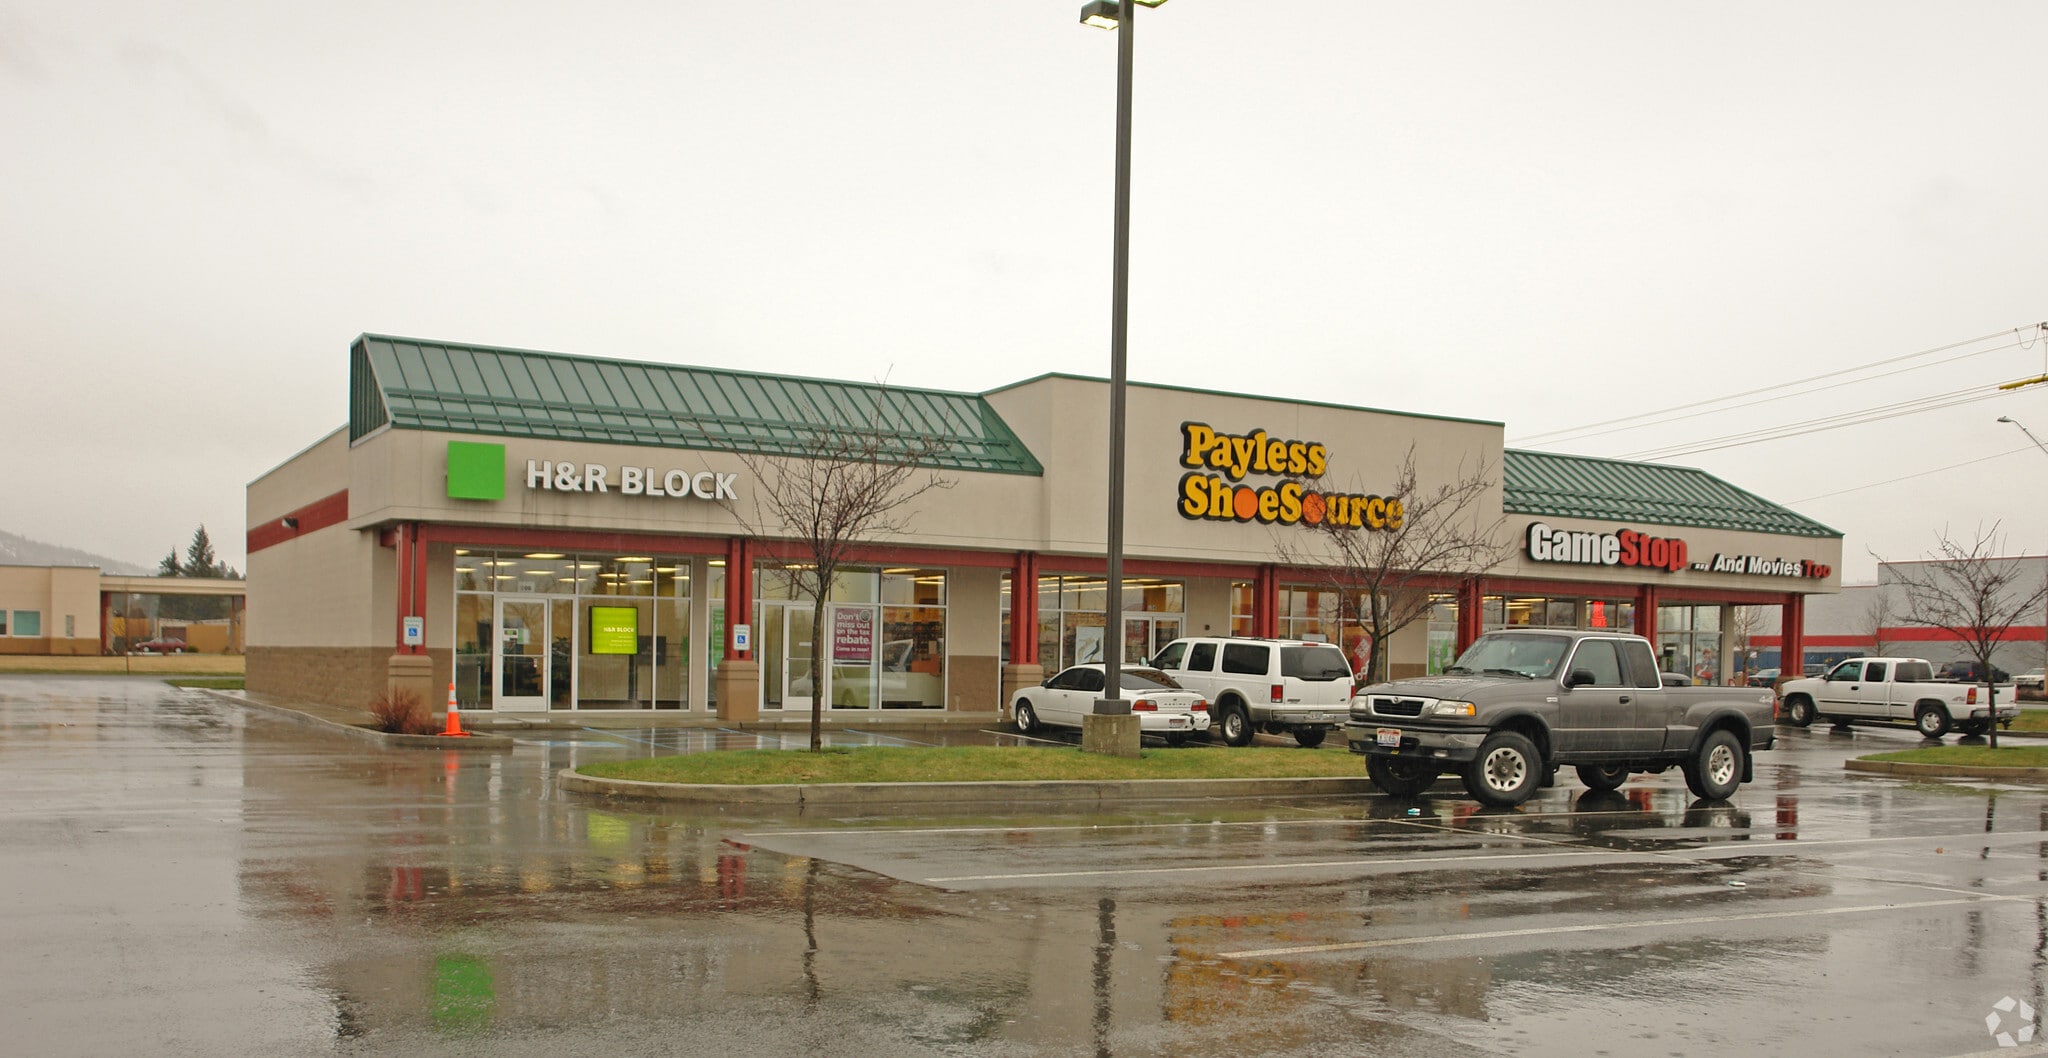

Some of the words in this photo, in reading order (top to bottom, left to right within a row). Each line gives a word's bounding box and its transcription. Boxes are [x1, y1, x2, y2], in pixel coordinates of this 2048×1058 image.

[1182, 422, 1326, 480] Payless
[527, 459, 608, 493] H&R
[621, 466, 738, 500] BLOCK
[1180, 473, 1404, 530] ShoeSource
[1528, 523, 1688, 572] GameStop
[1714, 553, 1745, 573] And
[1750, 556, 1801, 576] Movies
[1804, 559, 1832, 578] Too
[837, 612, 860, 621] Don't
